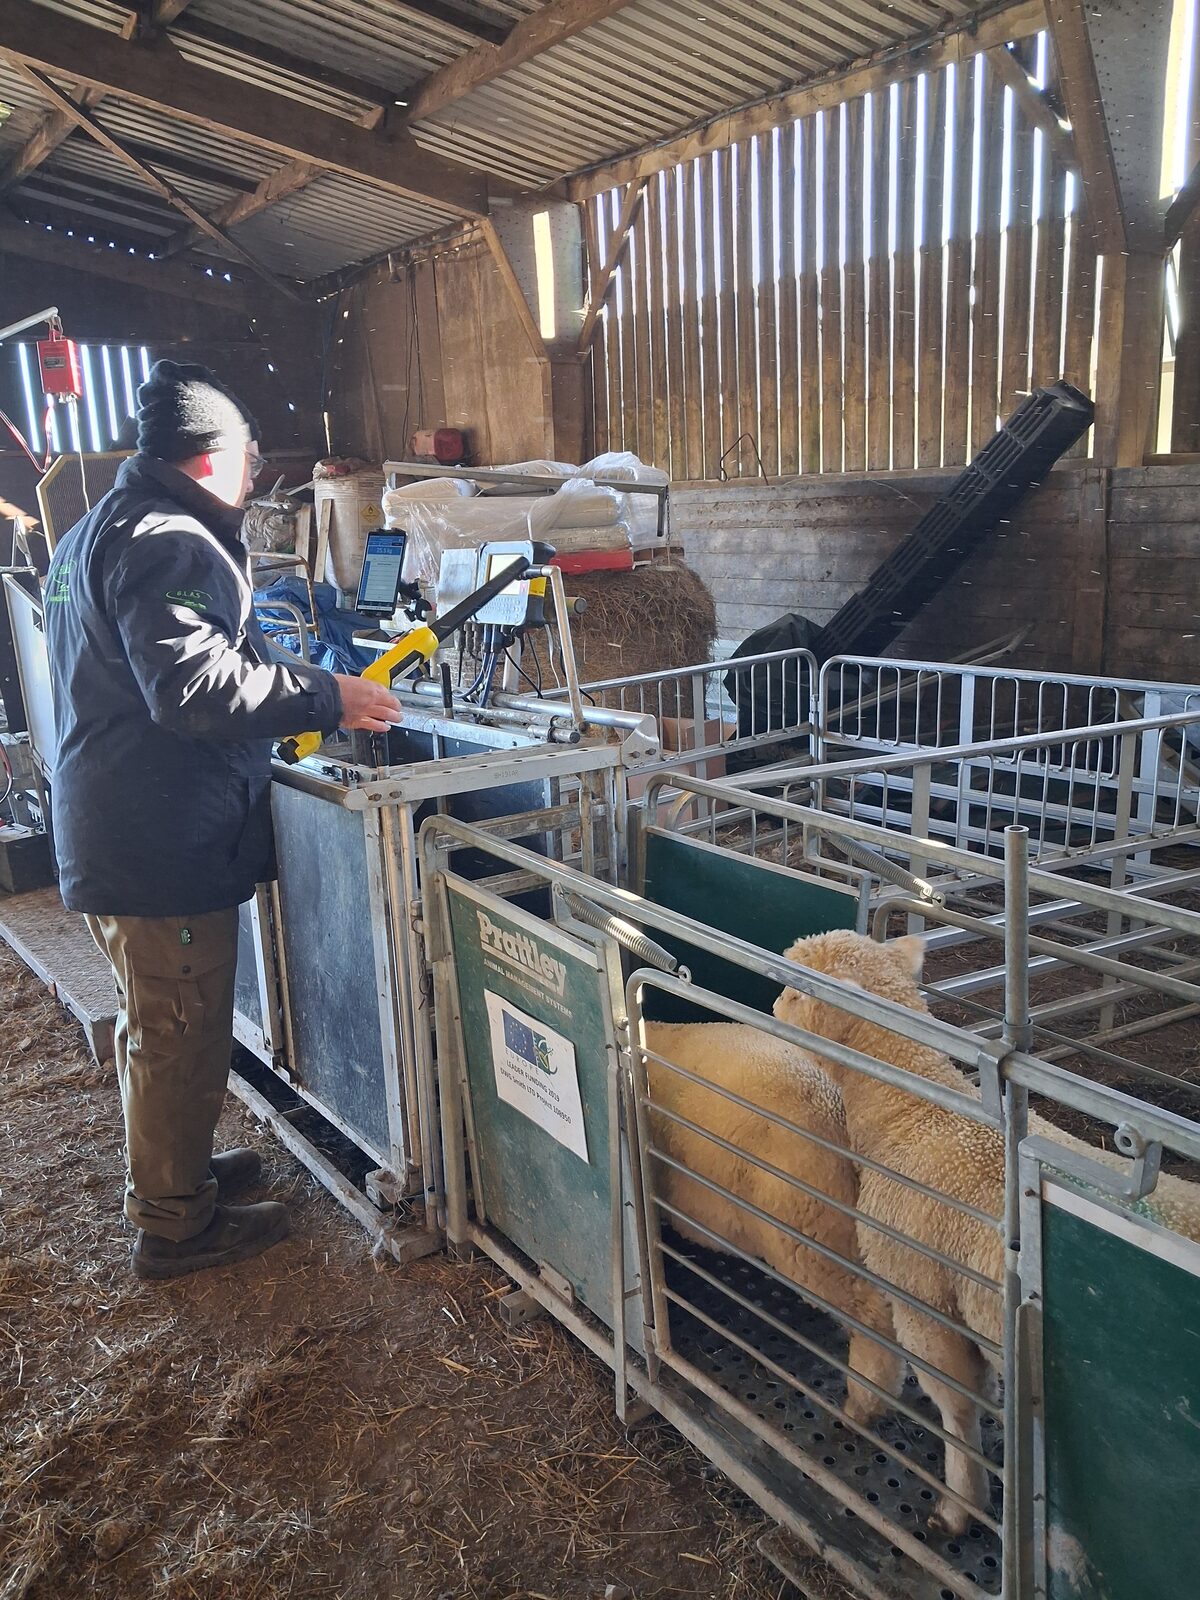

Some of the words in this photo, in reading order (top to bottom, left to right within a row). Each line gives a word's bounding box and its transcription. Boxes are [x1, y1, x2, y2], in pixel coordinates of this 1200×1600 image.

[476, 910, 566, 997] Prattley
[484, 958, 505, 976] ANIMAL
[505, 970, 545, 999] MANAGEMENT
[546, 995, 573, 1018] SYSTEMS
[506, 1060, 525, 1077] LEADER
[525, 1072, 548, 1093] FUNDING
[548, 1088, 560, 1102] 2019
[512, 1076, 526, 1090] Smith
[526, 1083, 536, 1096] LTD
[536, 1091, 553, 1110] Project
